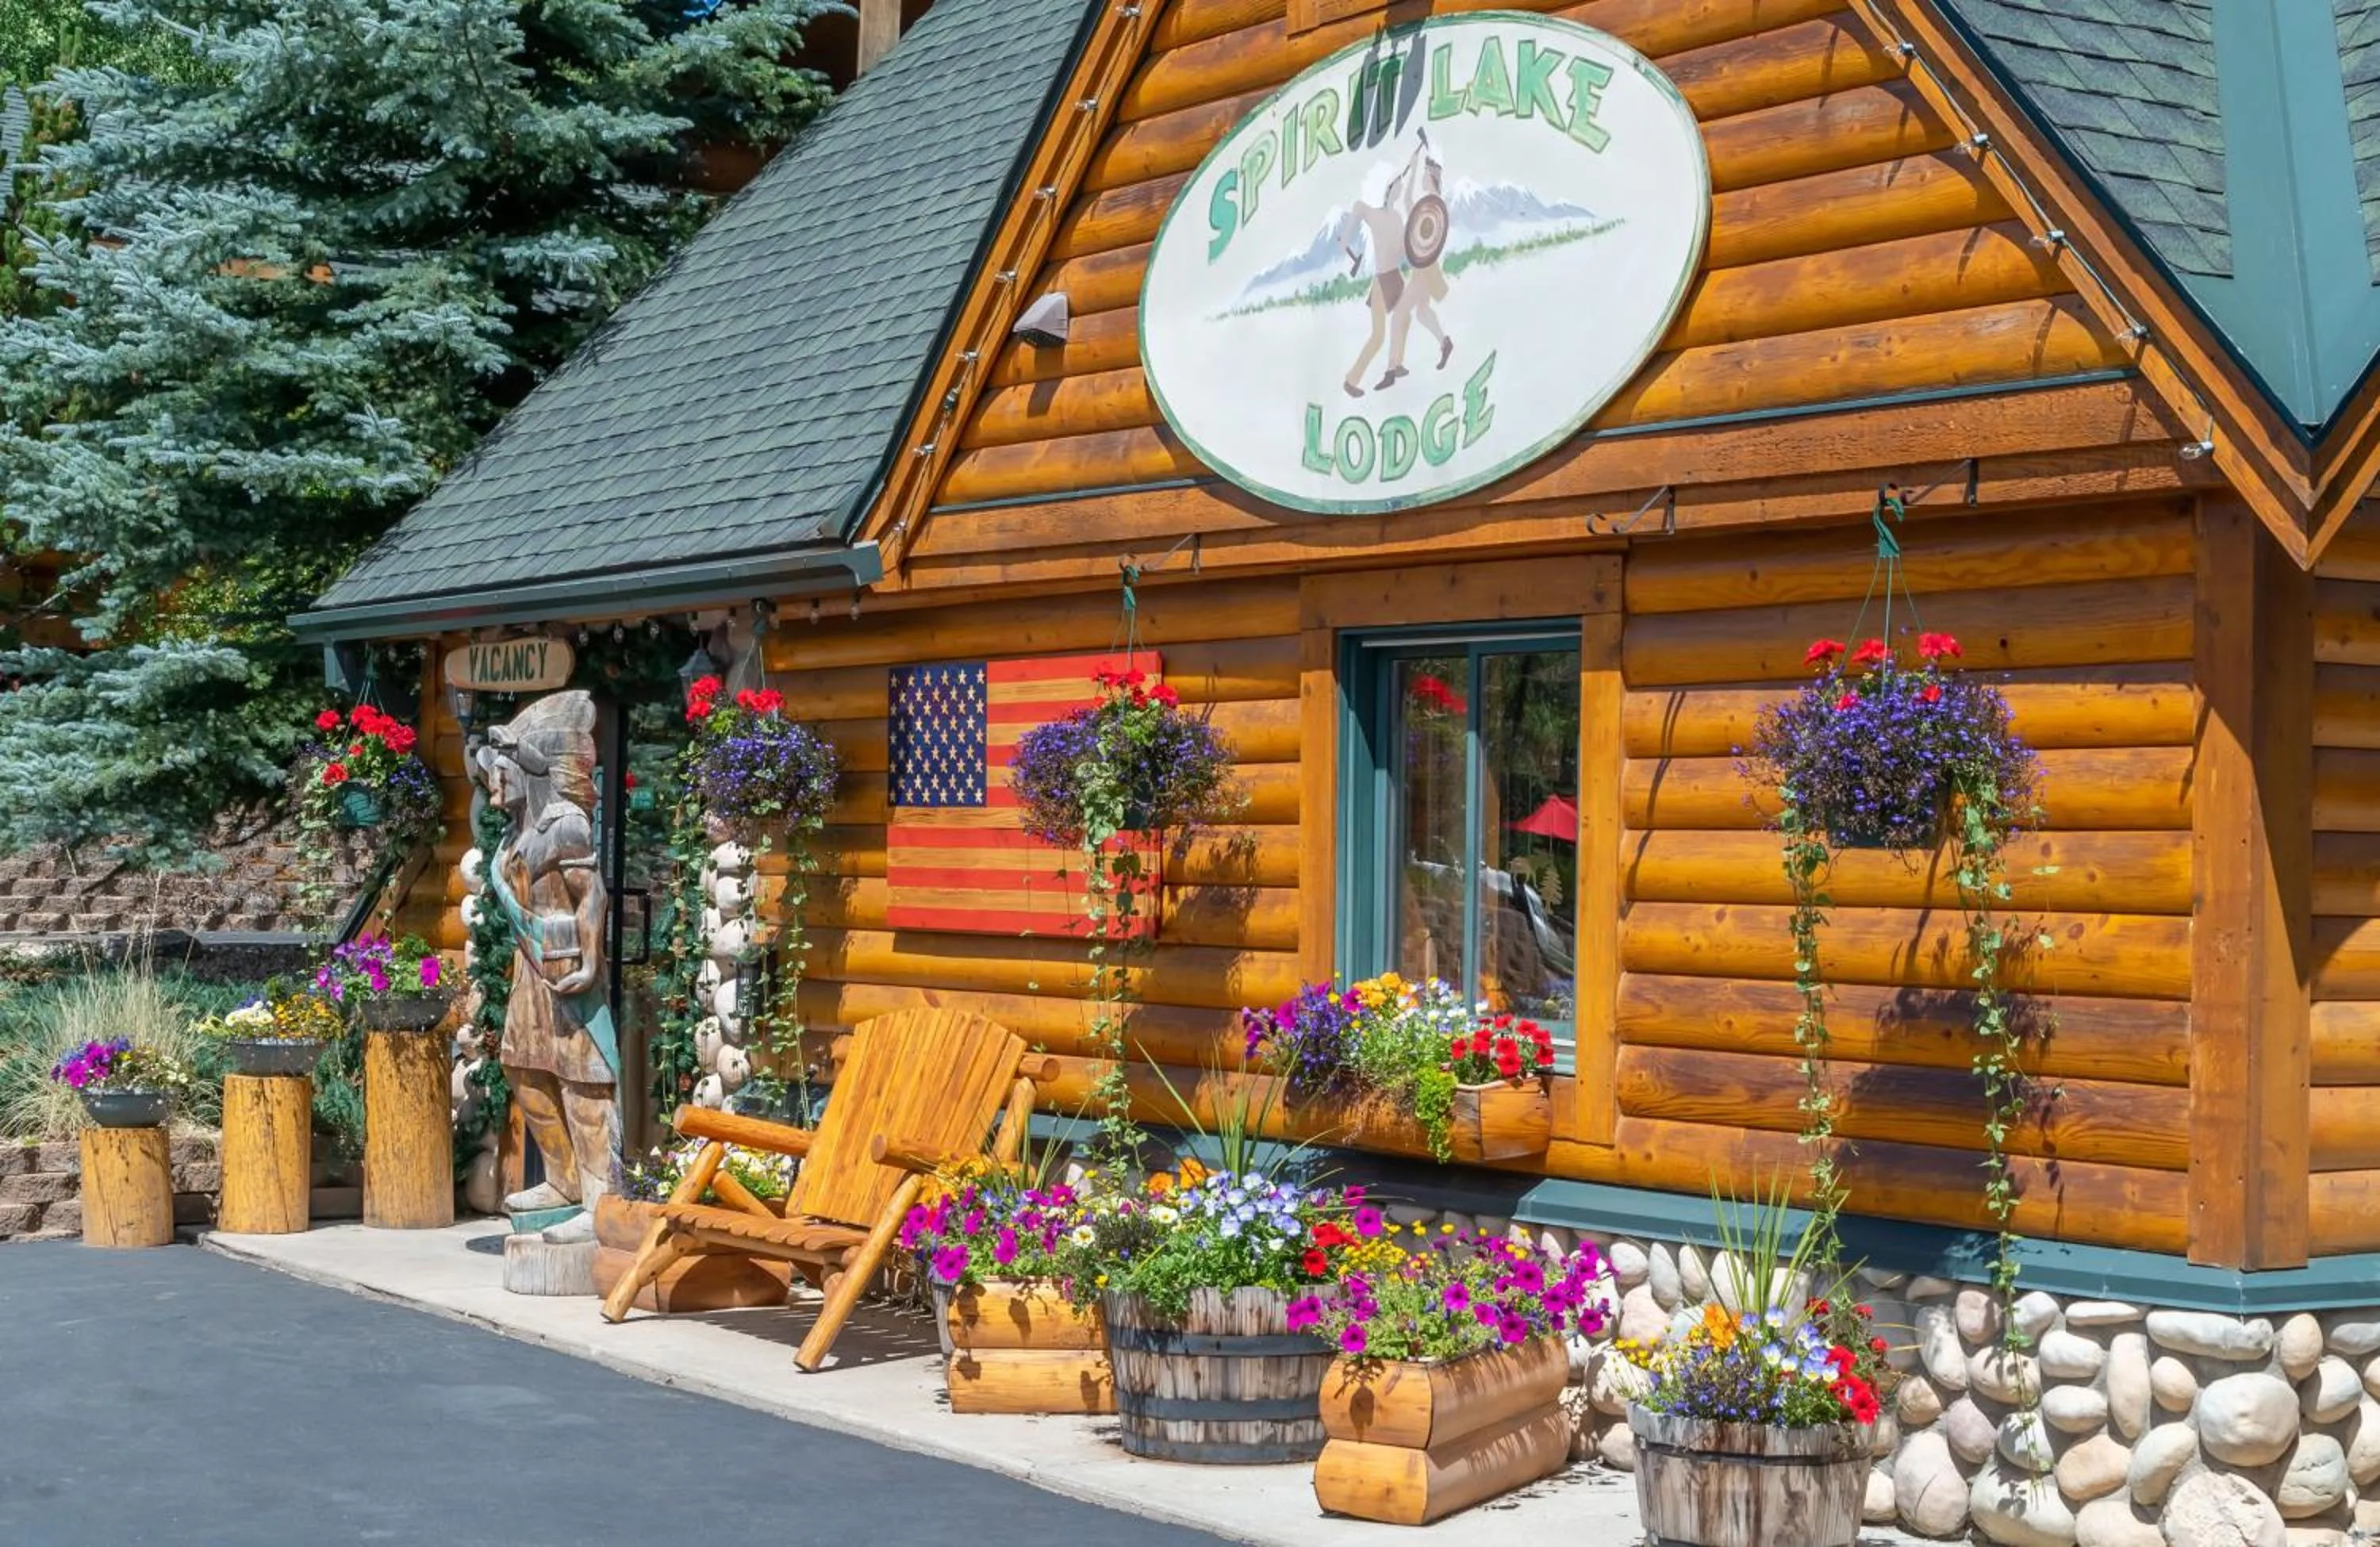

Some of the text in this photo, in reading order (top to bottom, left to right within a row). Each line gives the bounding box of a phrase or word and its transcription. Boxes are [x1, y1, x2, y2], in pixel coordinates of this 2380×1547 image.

[1207, 36, 1614, 266] SPIRIT LAKE
[1302, 349, 1497, 484] LODGE
[469, 643, 548, 683] VACANCY
